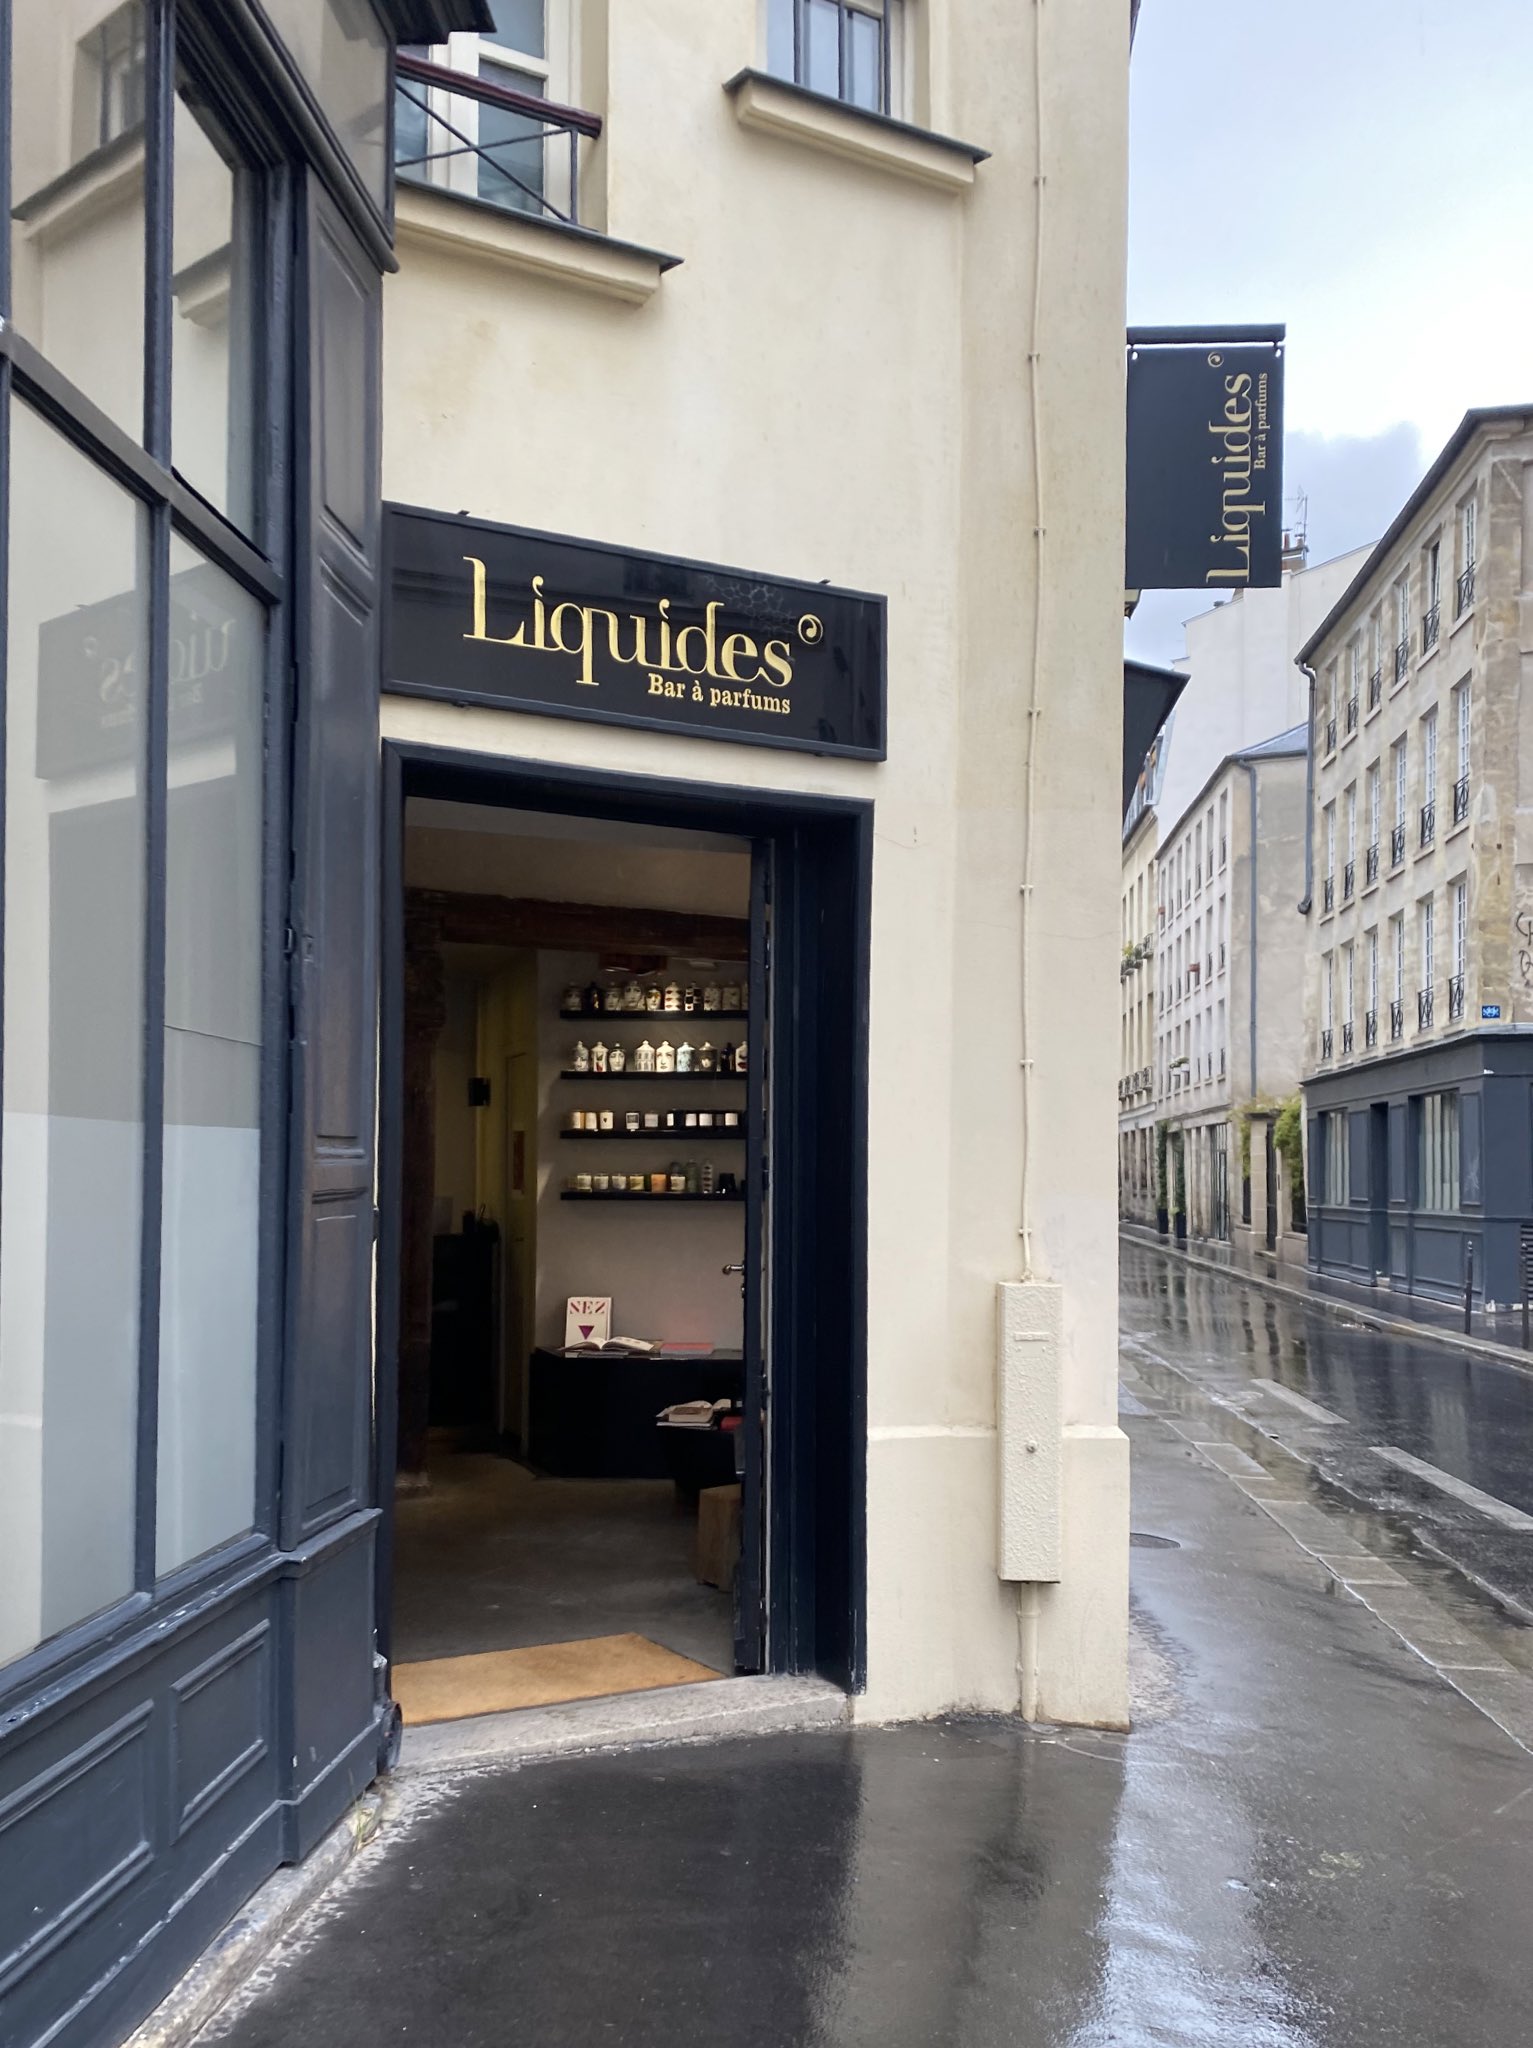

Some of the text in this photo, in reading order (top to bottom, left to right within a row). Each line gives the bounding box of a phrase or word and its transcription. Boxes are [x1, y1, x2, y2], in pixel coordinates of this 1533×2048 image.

[1254, 372, 1271, 470] Bar à parfums
[1206, 373, 1266, 584] Liquides
[463, 556, 793, 686] Liquides
[647, 672, 791, 714] Bar à parfums
